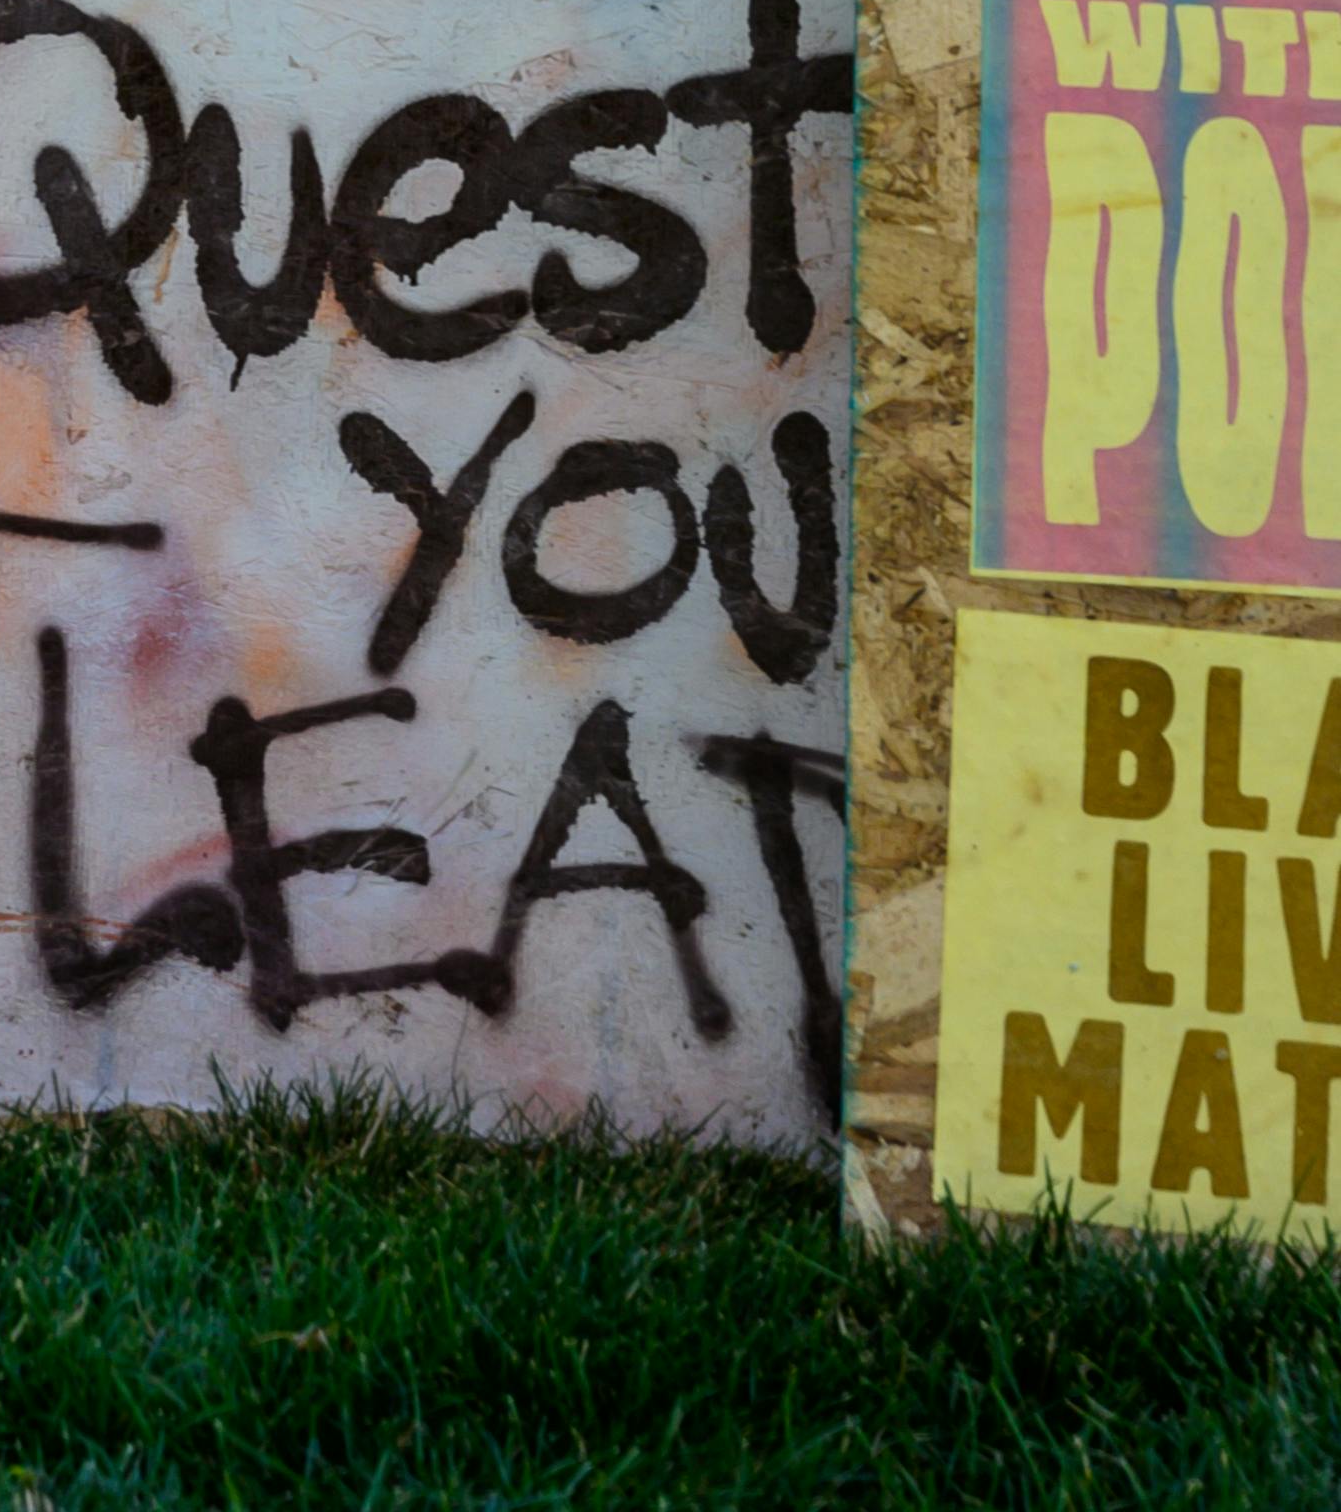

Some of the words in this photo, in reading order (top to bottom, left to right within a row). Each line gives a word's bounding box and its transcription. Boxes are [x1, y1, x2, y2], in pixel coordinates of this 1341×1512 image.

[337, 389, 839, 686] YOU
[1107, 840, 1341, 1025] LIV
[997, 1011, 1341, 1205] MAT
